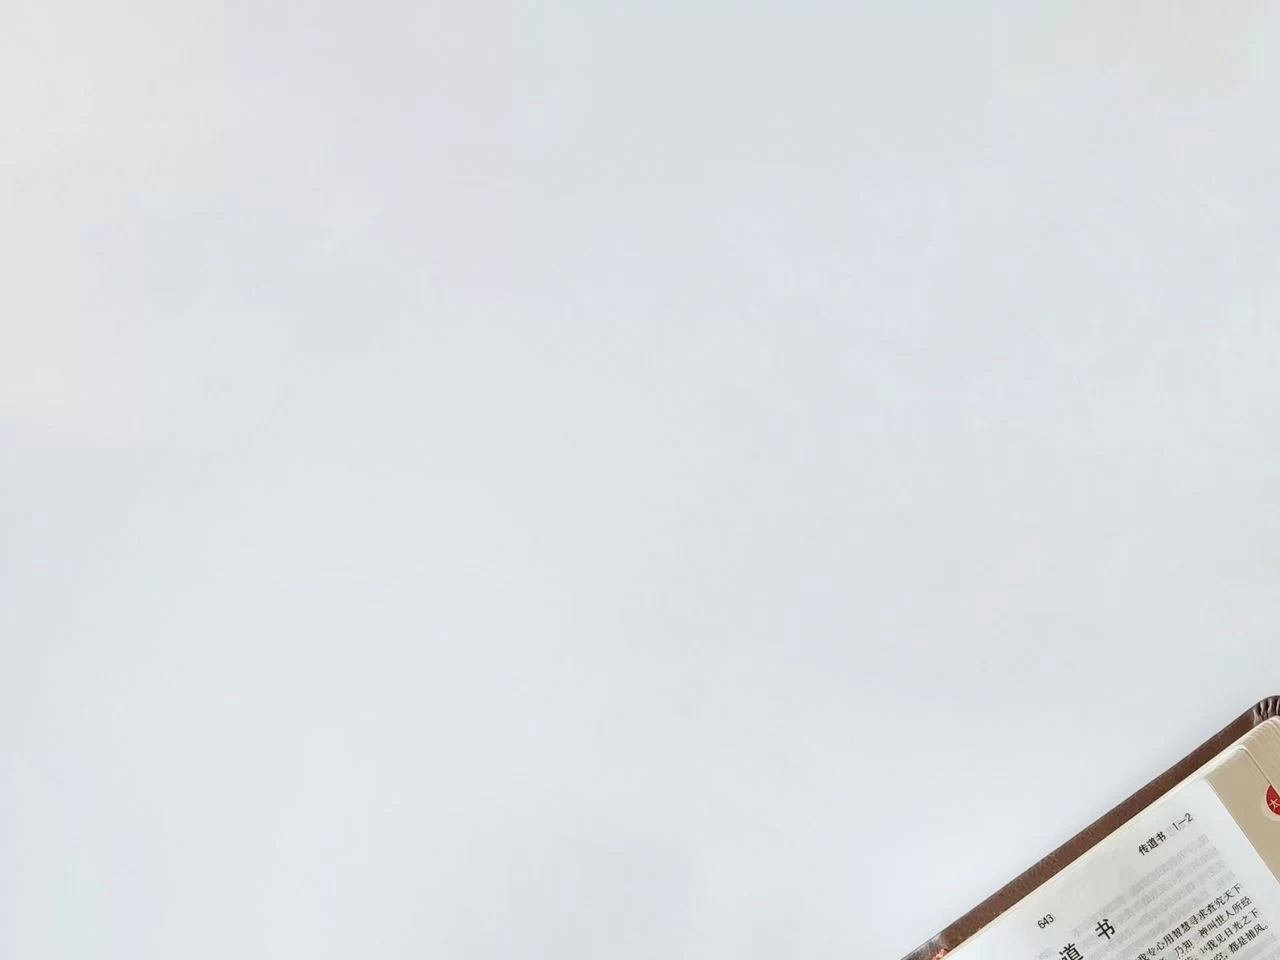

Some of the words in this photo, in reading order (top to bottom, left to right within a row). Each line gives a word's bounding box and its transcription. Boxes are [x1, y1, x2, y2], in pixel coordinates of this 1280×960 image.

[1138, 831, 1166, 856] 传道书
[1038, 914, 1054, 930] 643
